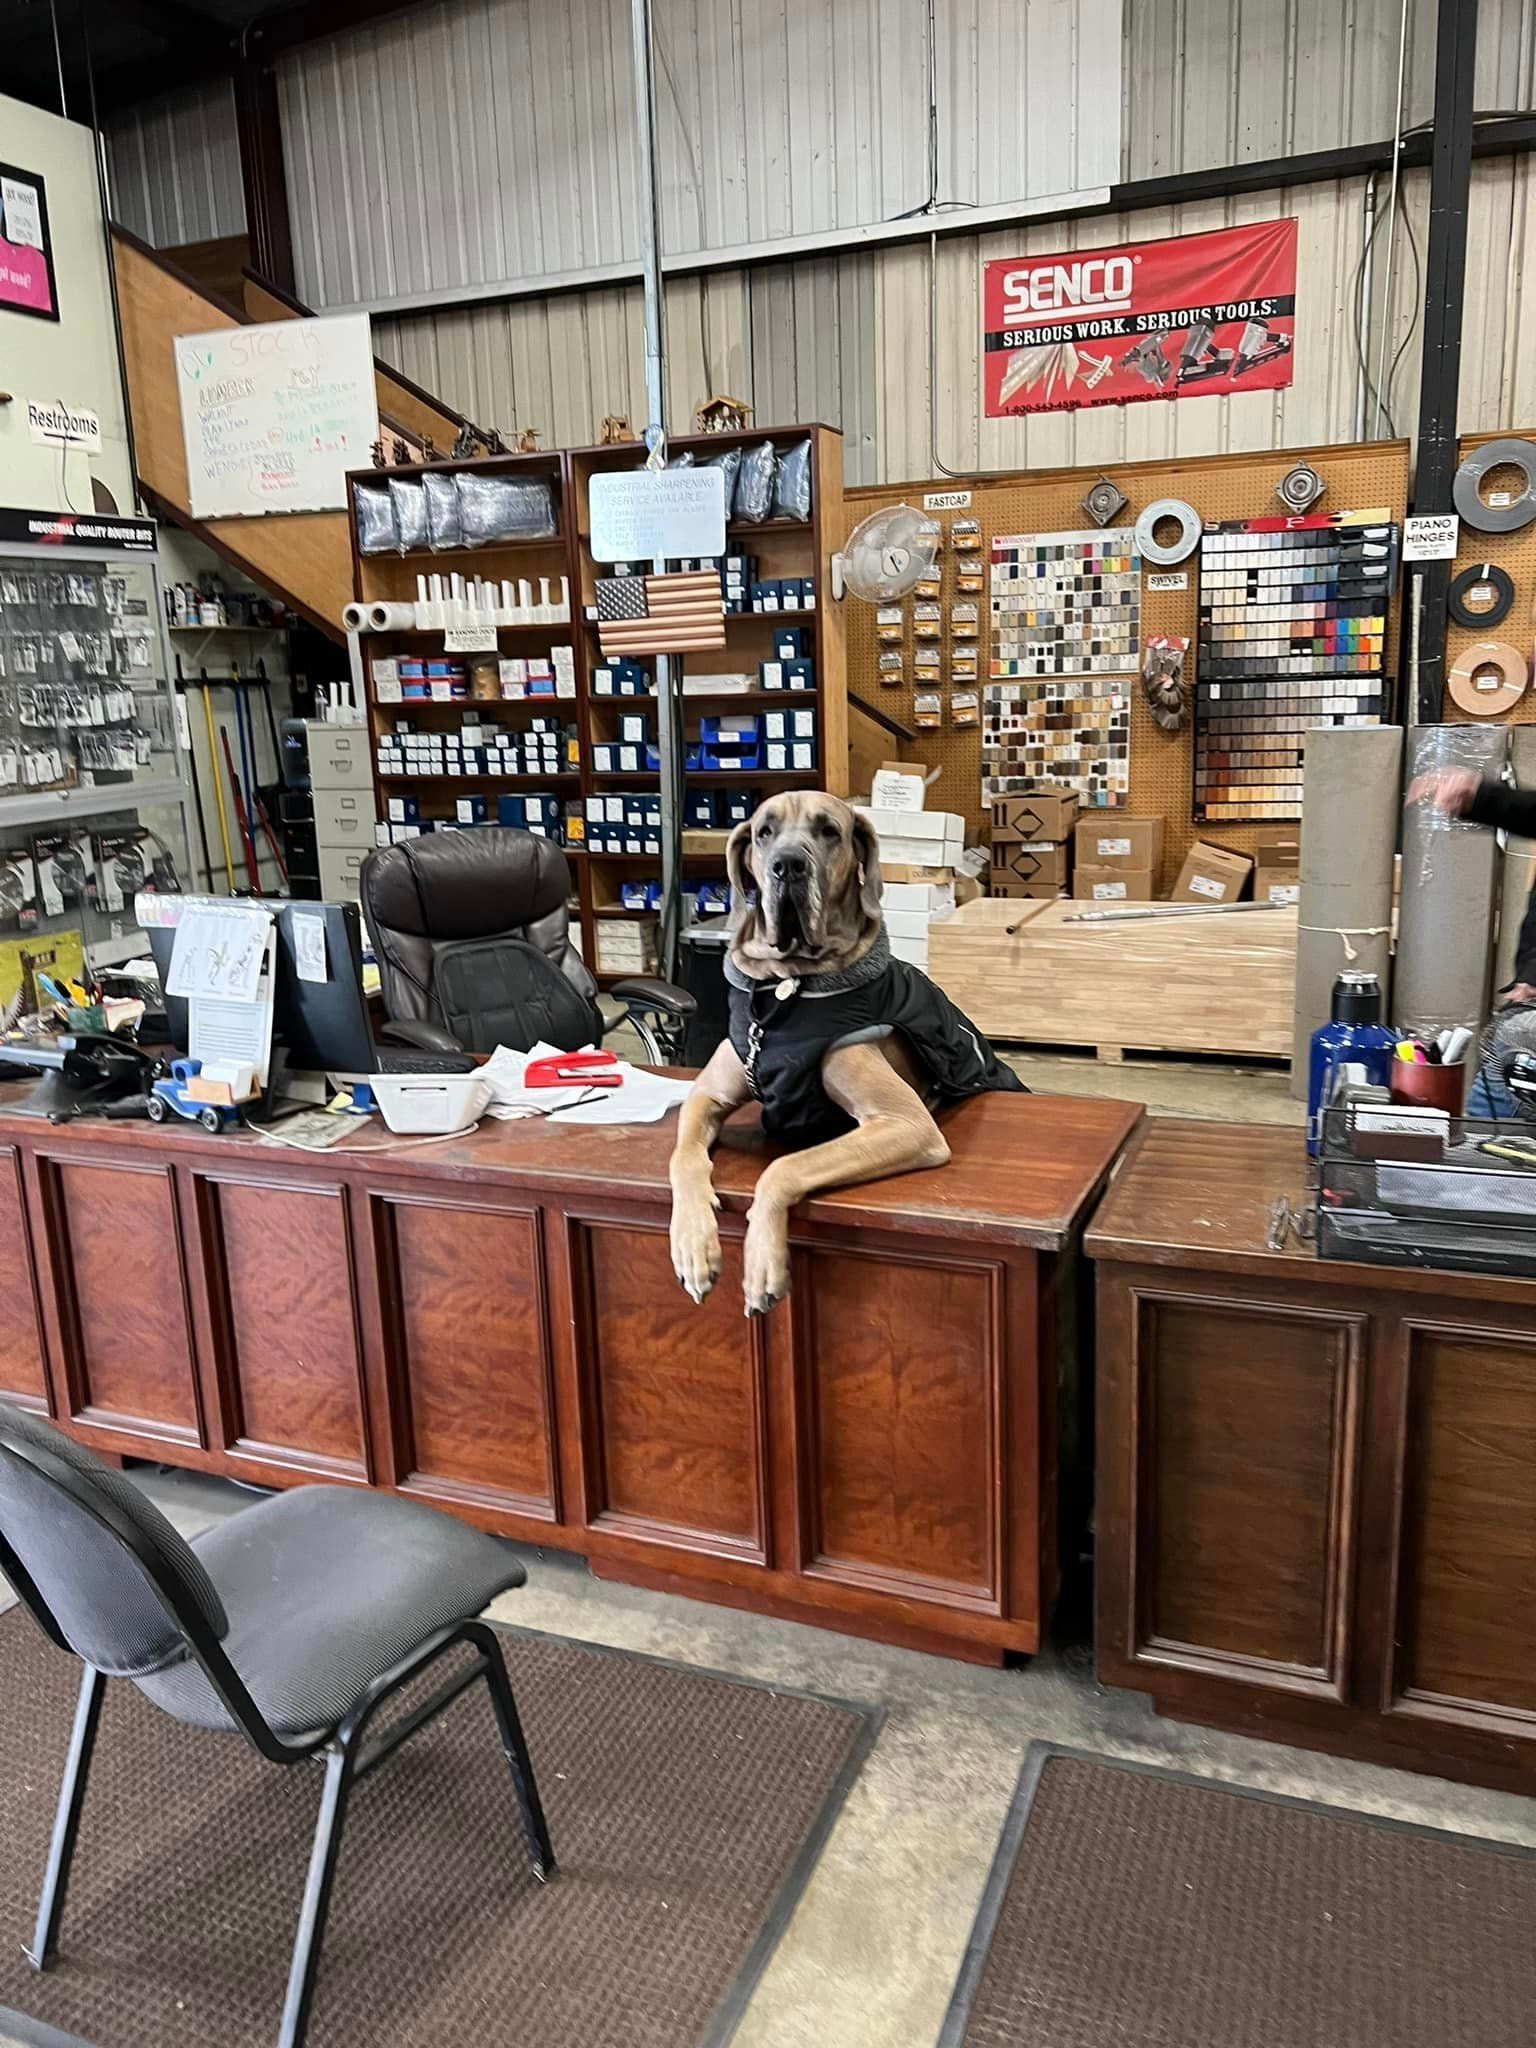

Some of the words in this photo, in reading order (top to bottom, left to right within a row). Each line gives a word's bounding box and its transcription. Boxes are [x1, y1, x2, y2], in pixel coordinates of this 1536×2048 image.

[1003, 256, 1133, 315] SENCO
[1003, 324, 1073, 348] SERIOUS
[1076, 316, 1131, 339] WORK.
[1136, 306, 1211, 331] SERIOUS
[1090, 390, 1179, 409] www.senco.com
[28, 405, 98, 436] Restrooms
[927, 494, 969, 508] FASTCAP
[28, 519, 76, 536] INDUSTRIAL
[75, 523, 106, 539] QUALITY
[106, 526, 136, 541] ROUTER
[136, 528, 153, 542] BITS
[1410, 518, 1452, 531] PIANO
[1406, 531, 1456, 545] HINGES
